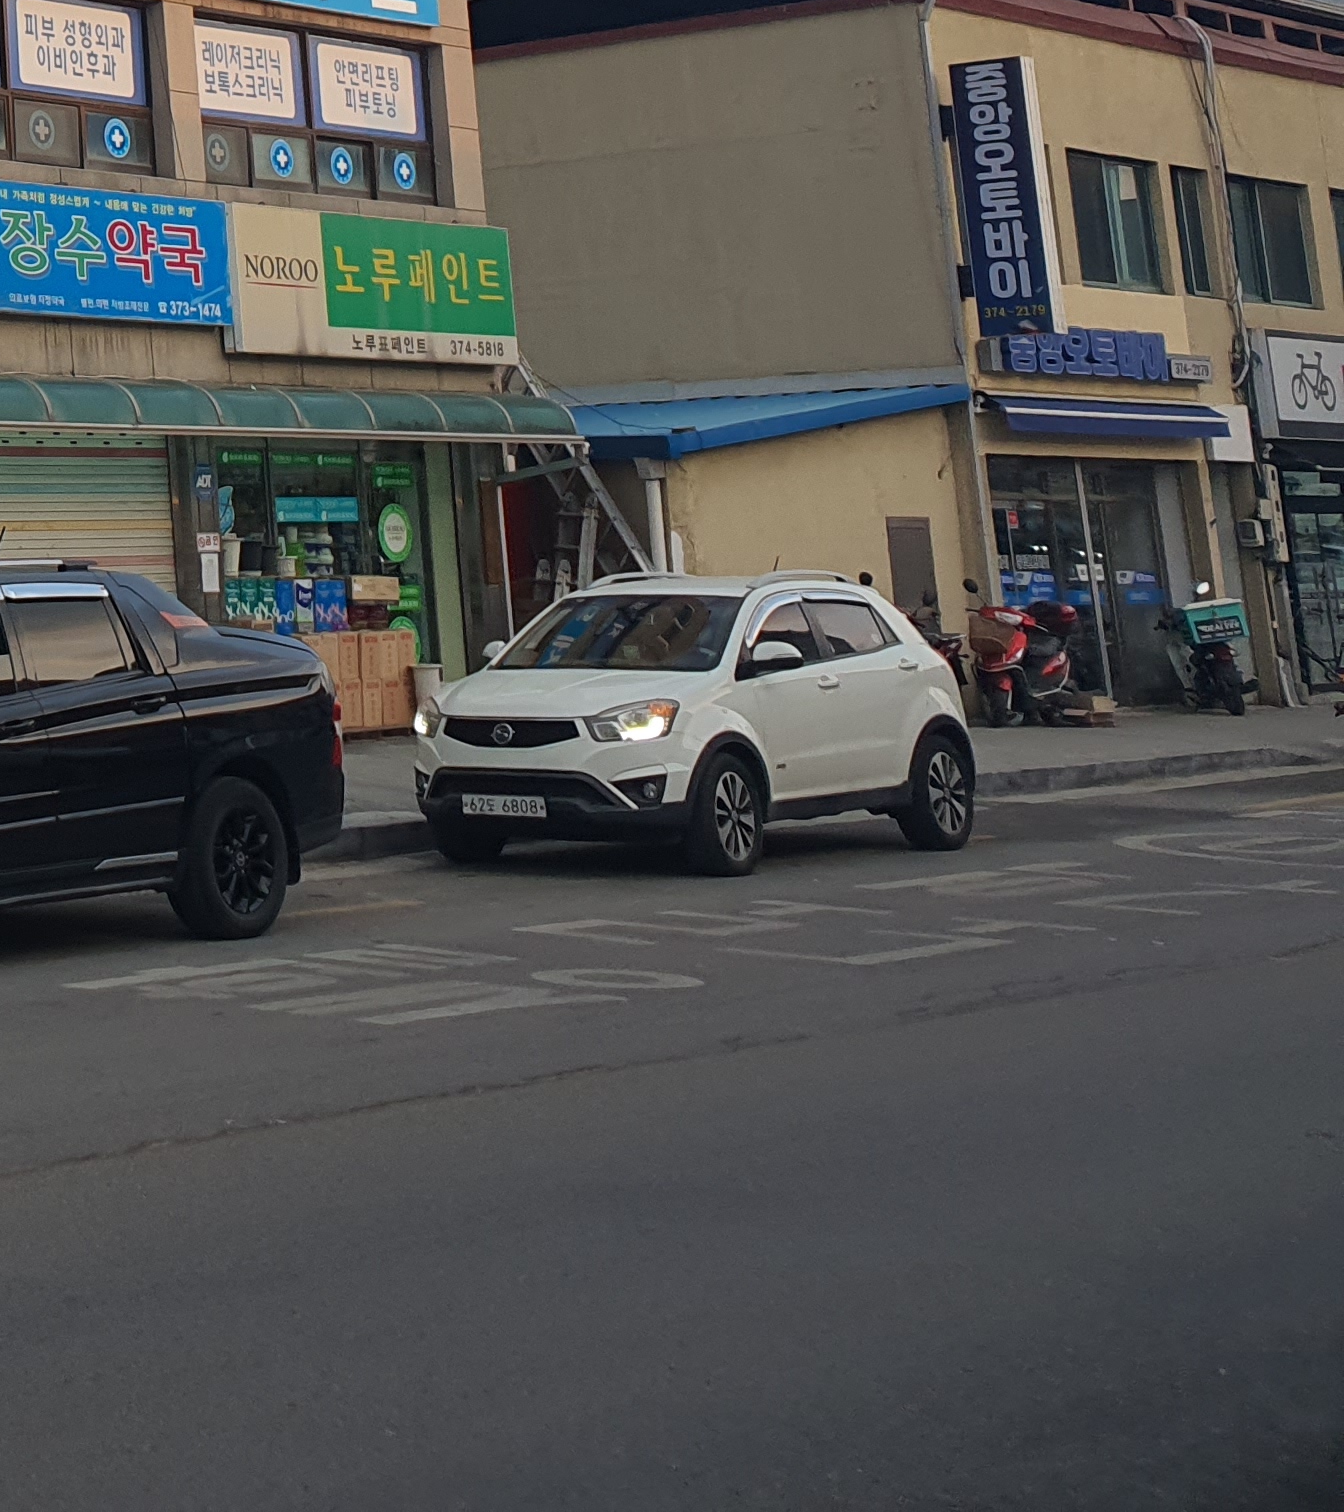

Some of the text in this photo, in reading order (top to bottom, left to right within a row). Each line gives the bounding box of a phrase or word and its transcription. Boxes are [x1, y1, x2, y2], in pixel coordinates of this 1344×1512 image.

[24, 13, 126, 55] 피부 성형외과
[36, 46, 117, 83] 이비인후과
[201, 39, 282, 75] 레이저크리닉
[333, 57, 400, 92] 안면리프팅
[203, 69, 285, 104] 보톡스크리닉
[344, 87, 398, 120] 피부토닝
[964, 61, 1032, 300] 중앙오토바이
[0, 207, 206, 287] 장수약국
[244, 253, 319, 283] NOROO
[333, 245, 505, 305] 노루페인트
[169, 300, 223, 321] 373-1474
[983, 304, 1047, 319] 374-2179
[351, 333, 429, 355] 노루표페인트
[449, 339, 505, 358] 374-5818
[1008, 326, 1170, 382] 중앙오토바이
[195, 474, 213, 489] ADT
[501, 798, 539, 815] 6808
